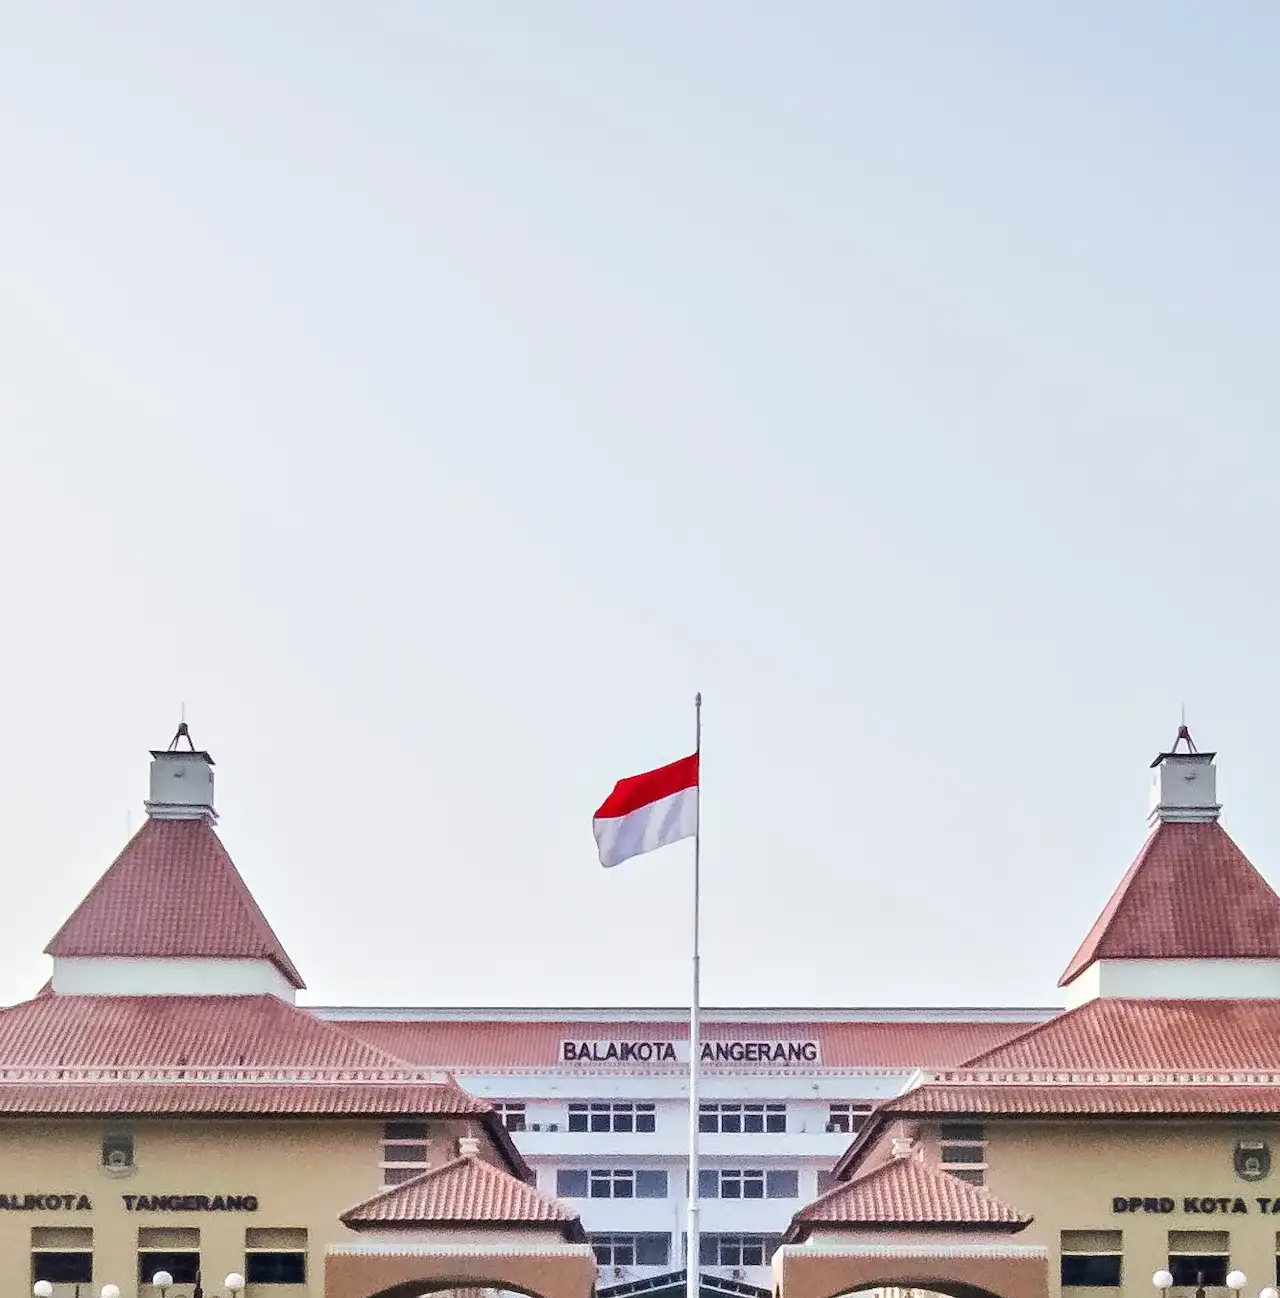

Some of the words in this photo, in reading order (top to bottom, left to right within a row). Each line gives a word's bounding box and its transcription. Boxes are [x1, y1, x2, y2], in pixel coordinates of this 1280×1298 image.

[562, 1041, 677, 1062] BALAIKOTA
[700, 1041, 817, 1062] ANGERANG
[122, 1194, 259, 1212] TANGERANG
[1112, 1197, 1175, 1214] DPRD
[1183, 1197, 1248, 1214] KOTA
